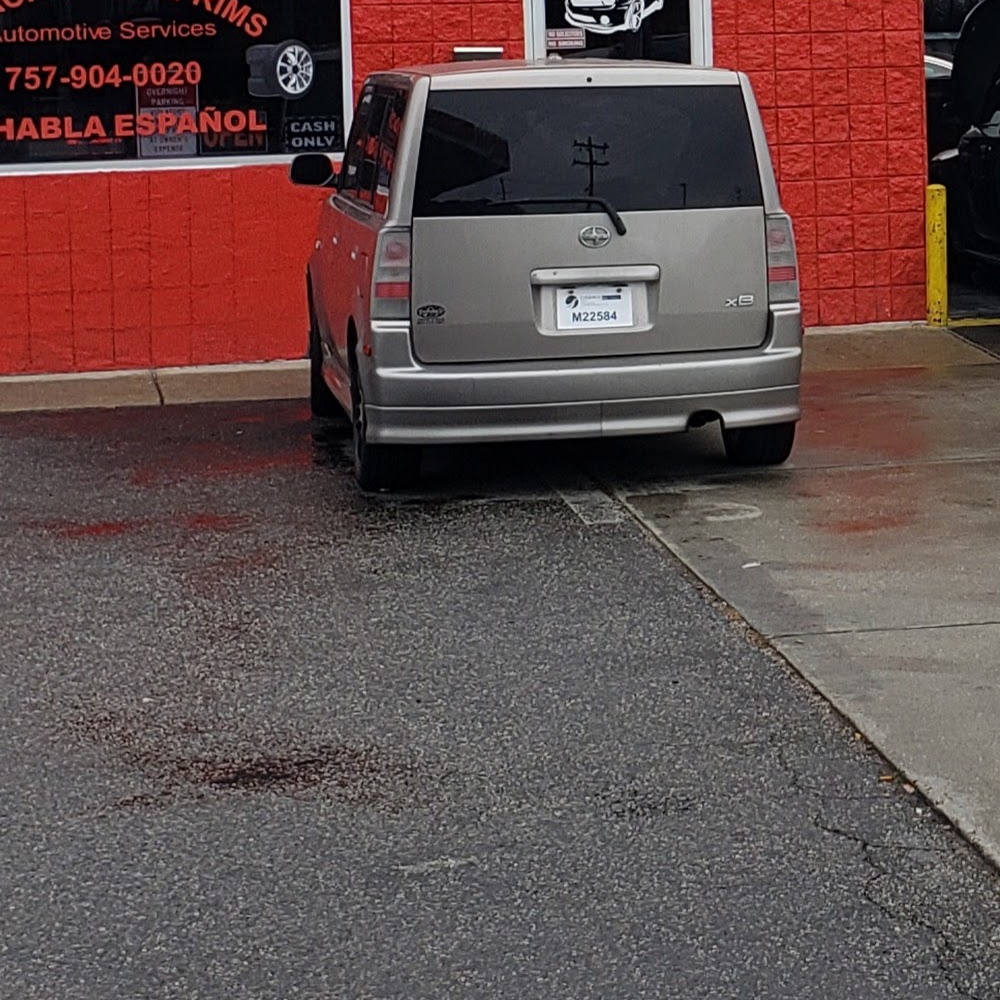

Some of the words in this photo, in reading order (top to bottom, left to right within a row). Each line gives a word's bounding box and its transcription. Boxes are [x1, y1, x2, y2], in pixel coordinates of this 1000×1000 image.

[0, 22, 111, 42] utomotive
[120, 20, 216, 40] Services
[5, 61, 202, 90] 757-904-0020
[114, 106, 267, 137] ESPAÑOL
[290, 121, 335, 133] CASH
[291, 136, 336, 148] ONLY
[724, 294, 754, 307] xB
[571, 310, 617, 323] M22584
